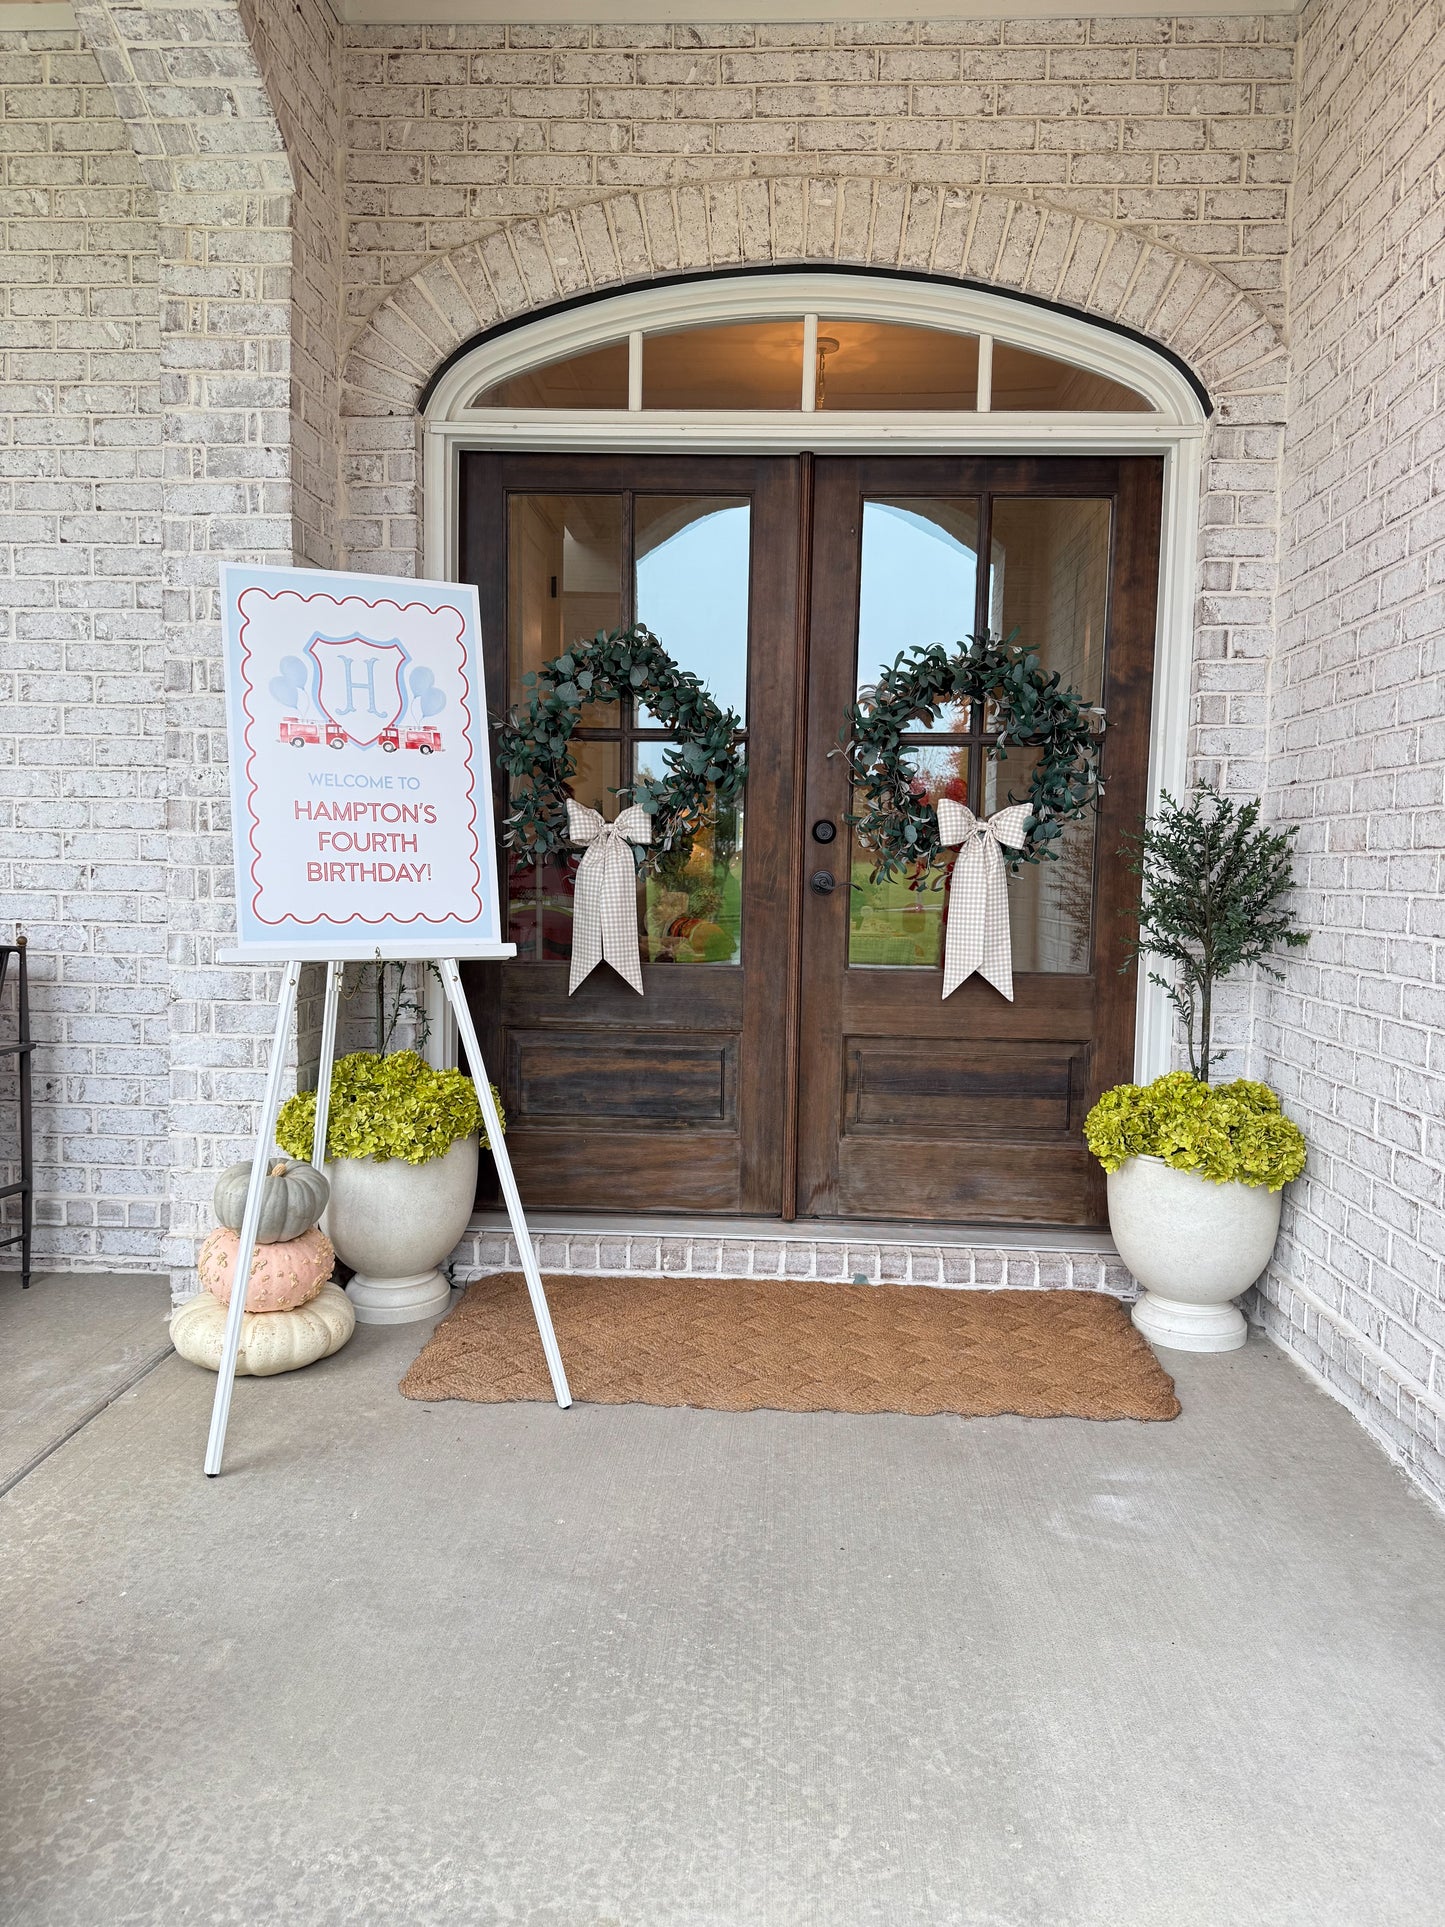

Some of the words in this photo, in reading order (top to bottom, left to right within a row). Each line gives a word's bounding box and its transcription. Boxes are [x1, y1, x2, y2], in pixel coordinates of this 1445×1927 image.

[335, 654, 388, 718] H
[308, 772, 393, 790] WELCOME
[397, 776, 420, 790] TO
[294, 800, 437, 824] HAMPTON'S
[318, 831, 418, 853] FOURTH
[307, 861, 433, 883] BIRTHDAY!
